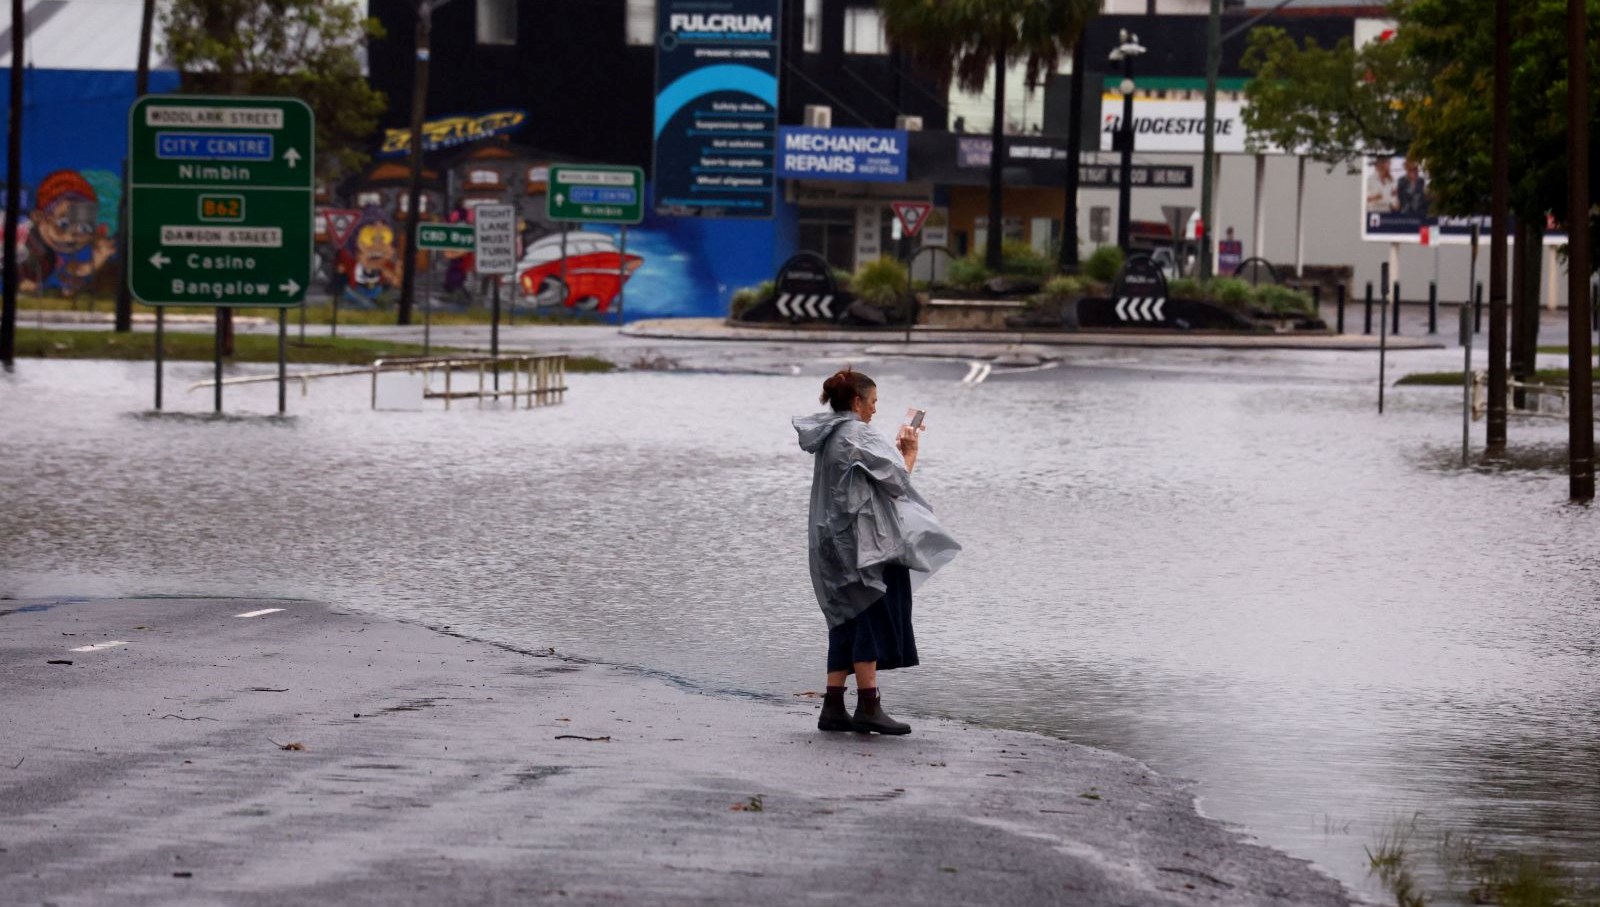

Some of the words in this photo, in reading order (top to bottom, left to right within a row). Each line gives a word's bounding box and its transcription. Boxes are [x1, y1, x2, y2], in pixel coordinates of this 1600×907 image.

[670, 13, 773, 33] FULCRUM
[151, 111, 223, 123] WOODLARK
[231, 112, 278, 125] STREET
[1104, 114, 1235, 135] BIDGESTONE
[163, 138, 199, 152] CITY
[207, 139, 267, 154] CENTRE
[785, 133, 900, 154] MECHANICAL
[784, 154, 855, 173] REPAIRS
[179, 165, 250, 180] Nimbin
[203, 200, 239, 216] B62
[480, 209, 511, 218] RIGHT
[480, 223, 509, 231] LANE
[164, 231, 221, 242] DAWSON
[228, 231, 278, 243] STREET
[421, 230, 447, 241] CBD
[450, 231, 474, 245] Byp
[480, 234, 510, 242] MUST
[481, 247, 511, 255] TURN
[187, 253, 256, 269] Casino
[480, 260, 511, 268] RIGHT
[171, 278, 270, 299] Bangalow
